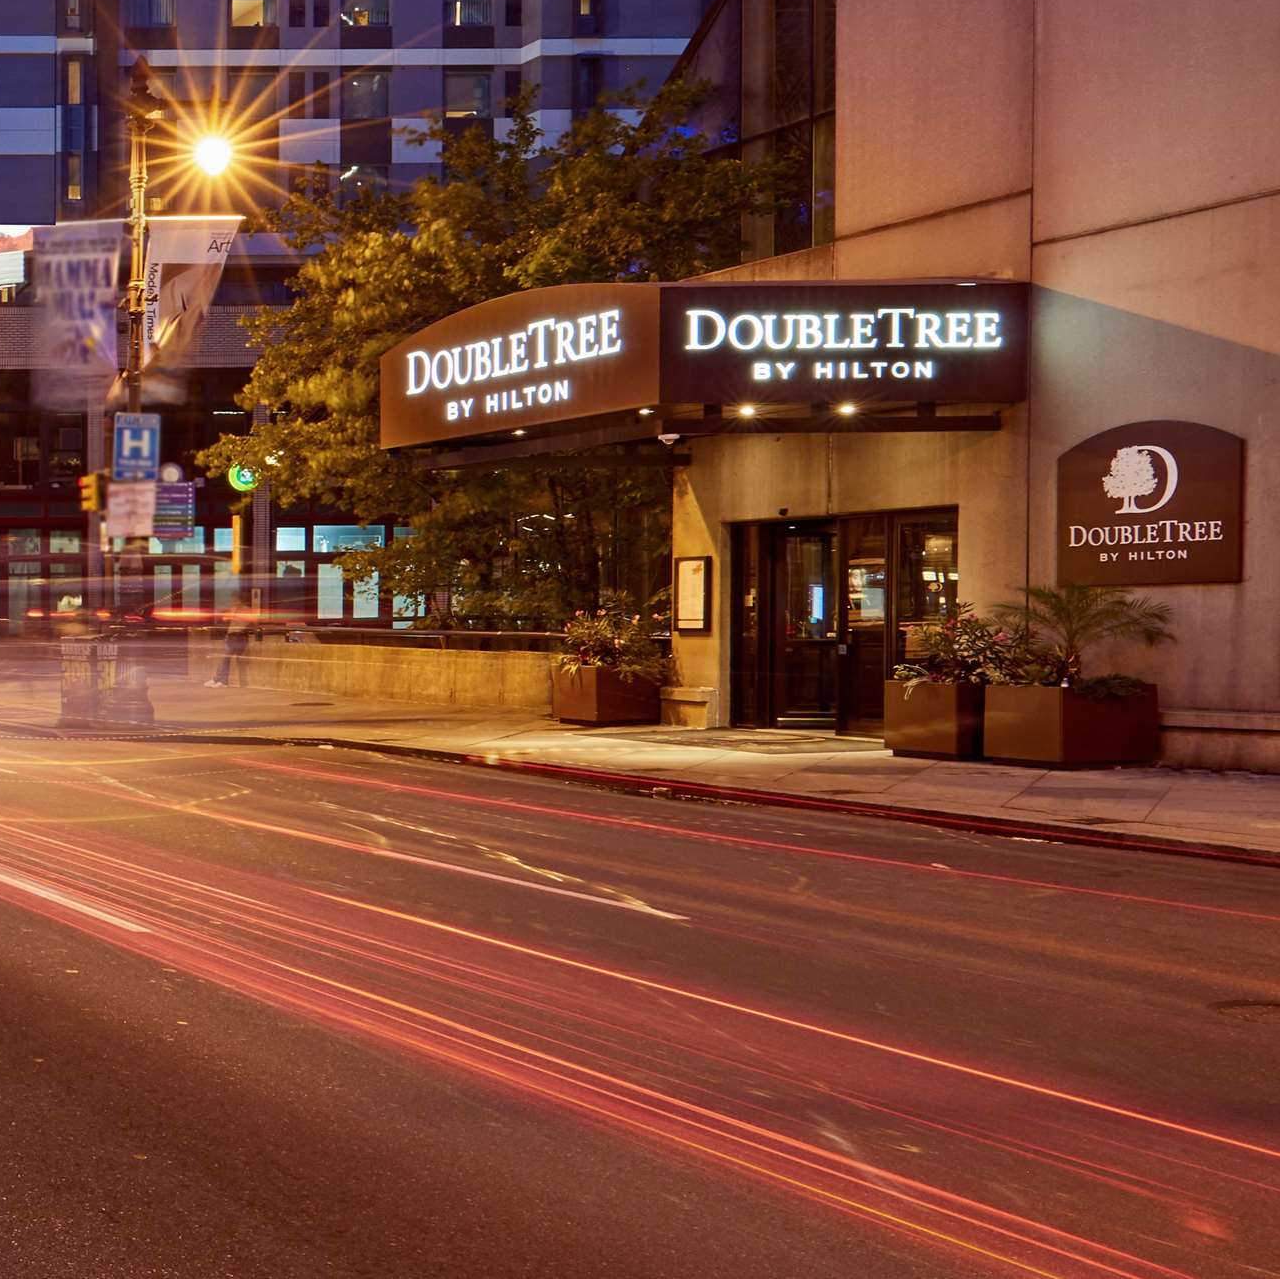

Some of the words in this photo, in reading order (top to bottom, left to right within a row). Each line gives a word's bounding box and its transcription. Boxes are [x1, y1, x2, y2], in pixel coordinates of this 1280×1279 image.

[207, 239, 232, 253] Art
[145, 308, 156, 341] Times
[685, 308, 1003, 350] DOUBLETREE
[406, 310, 623, 396] DOUBLETREE
[753, 362, 795, 380] BY
[815, 361, 933, 380] HILTON
[447, 398, 474, 420] BY
[486, 380, 569, 414] HILTON
[122, 429, 150, 457] H
[1069, 520, 1223, 547] DOUBLETREE
[1100, 552, 1119, 562] BY
[1129, 550, 1188, 561] HILTON
